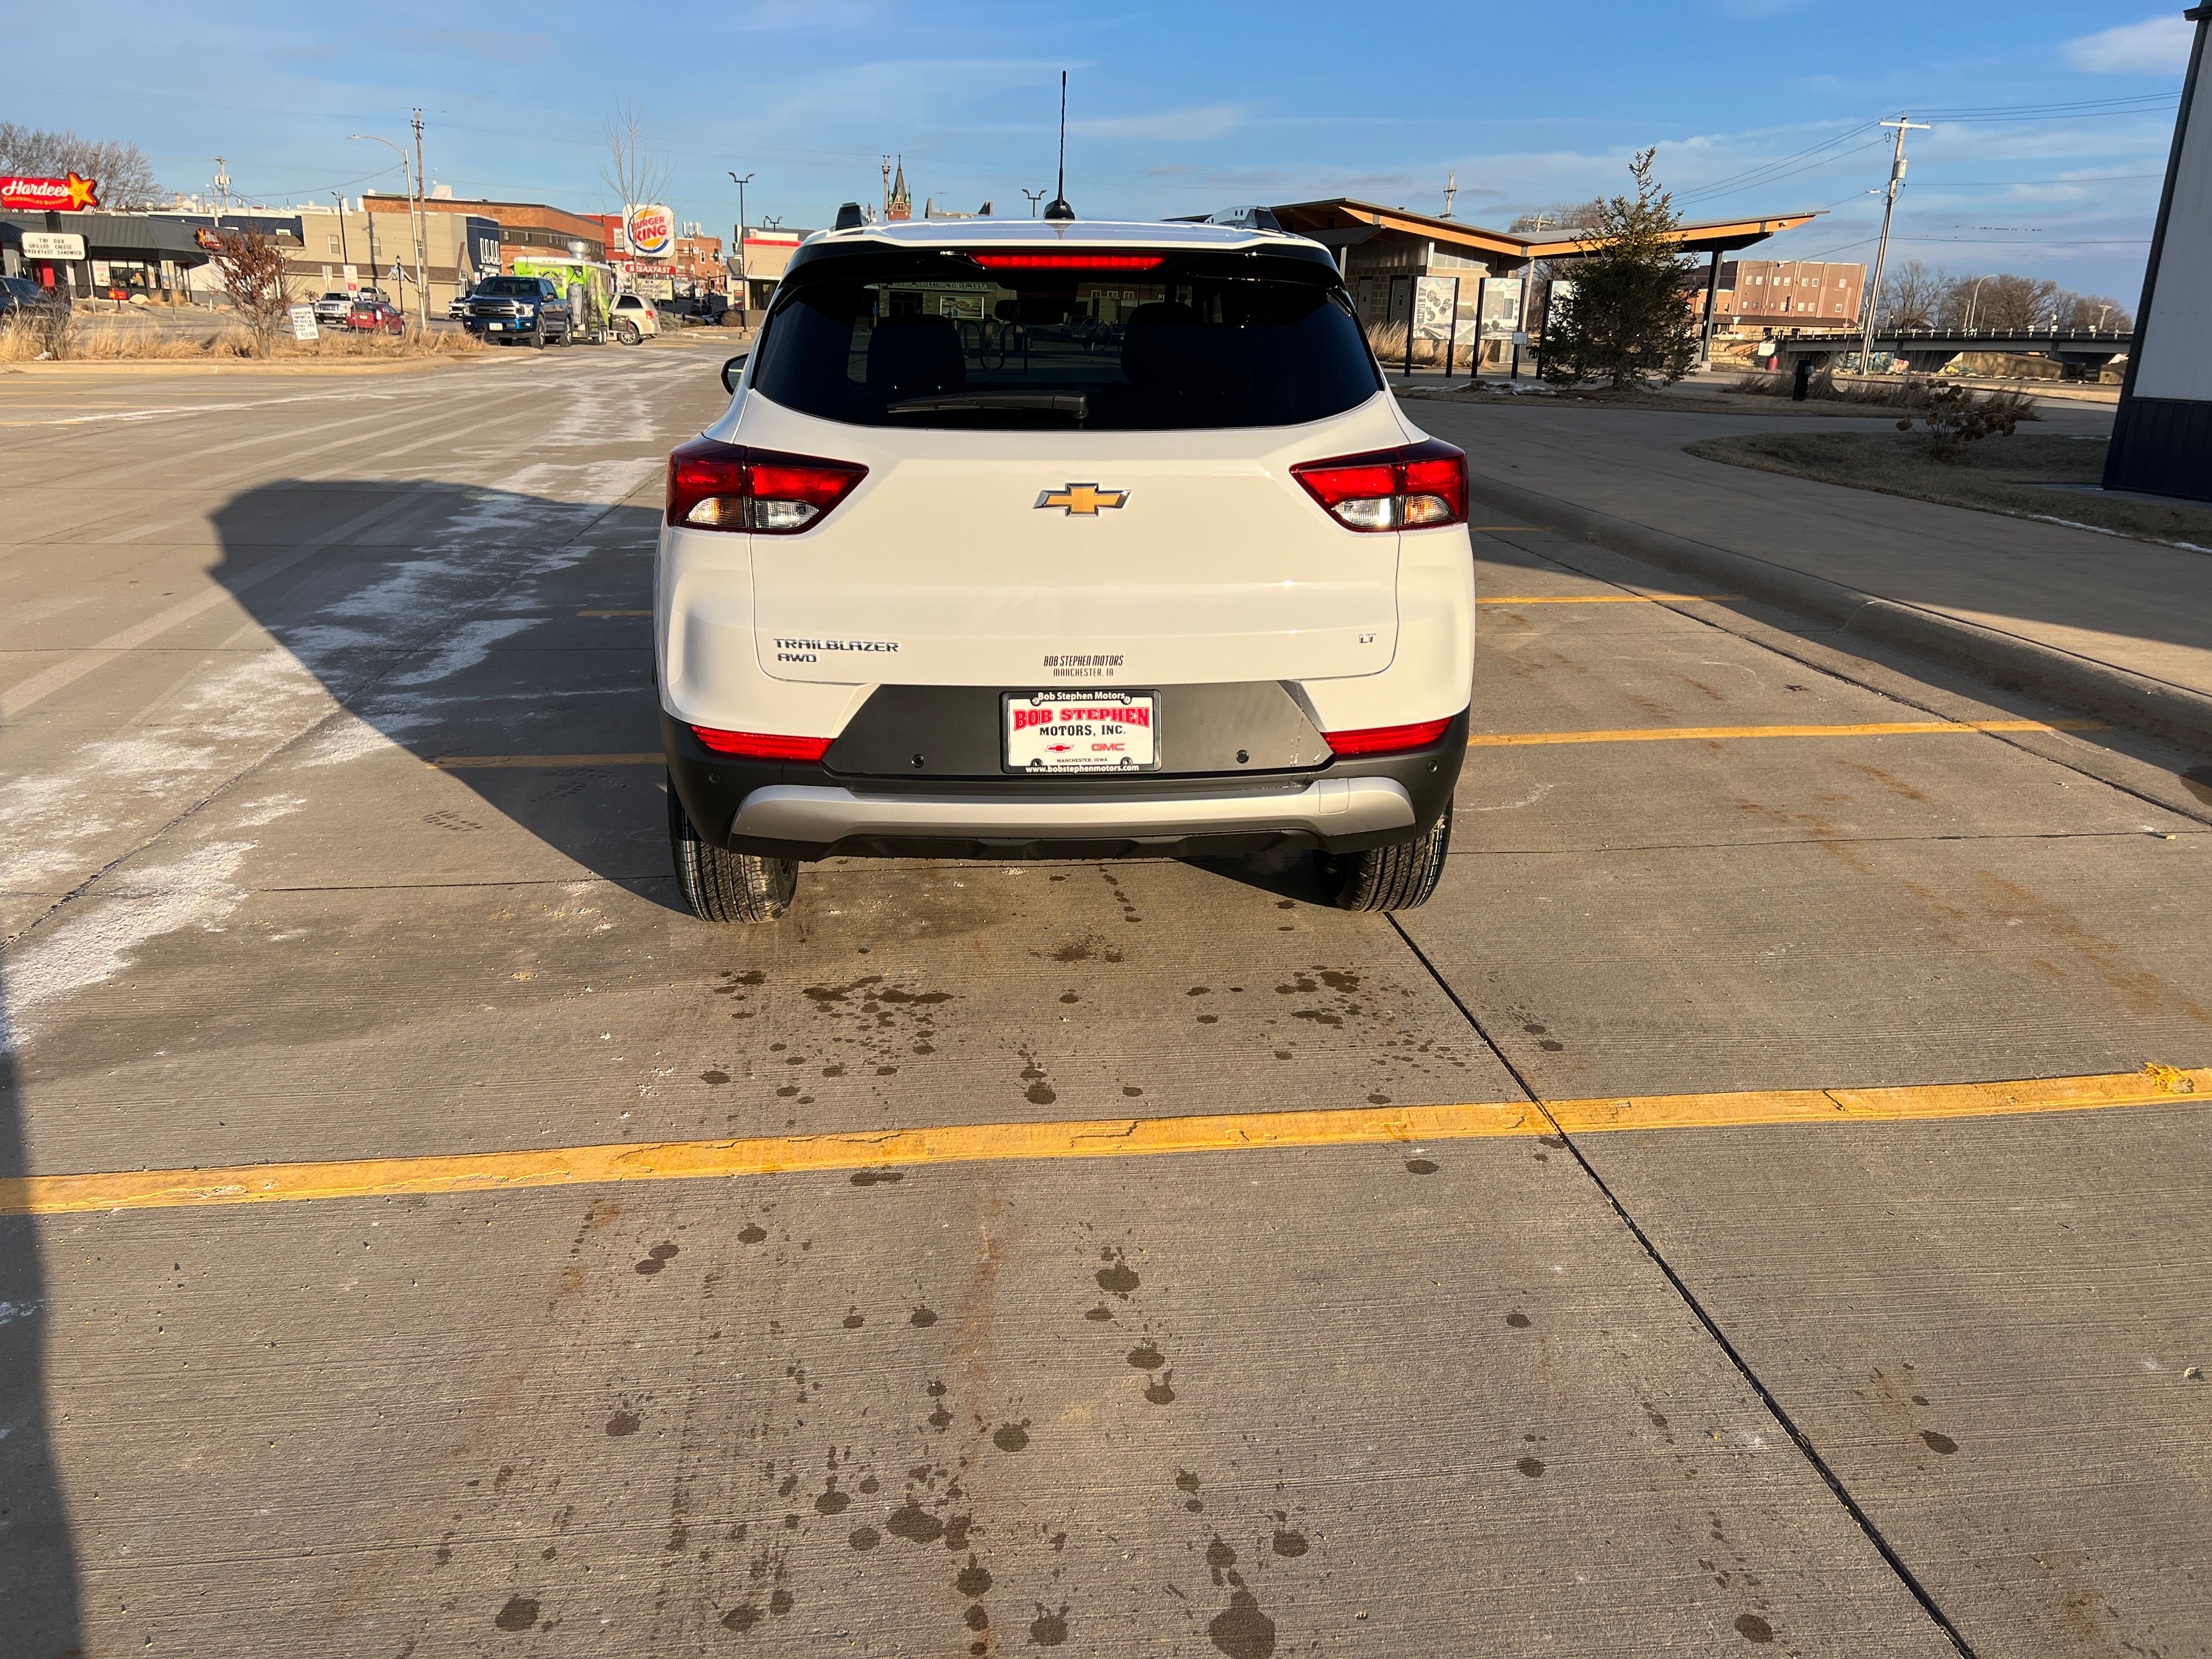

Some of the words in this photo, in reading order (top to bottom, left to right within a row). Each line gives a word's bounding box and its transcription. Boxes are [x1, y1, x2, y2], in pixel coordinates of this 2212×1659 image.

[2, 180, 69, 197] Hardee's
[631, 216, 665, 230] BURGER
[634, 225, 667, 242] KING
[1359, 633, 1376, 644] LT
[773, 638, 900, 652] TRAILBLAZER
[777, 653, 817, 662] AWD
[1043, 656, 1058, 667] BOB
[1059, 655, 1091, 667] STEPHEN
[1092, 655, 1124, 666] MOTORS
[1053, 668, 1104, 677] MANCHESTER,
[1107, 668, 1113, 676] IA
[1038, 692, 1056, 701] Bob
[1057, 692, 1093, 701] Stephen
[1014, 709, 1053, 731] BOB
[1059, 707, 1149, 728] STEPHEN
[1039, 725, 1096, 737] MOTORS,
[1101, 724, 1126, 736] INC.
[1091, 743, 1125, 751] GMC
[1025, 764, 1139, 773] www.bobstephenmotors.com
